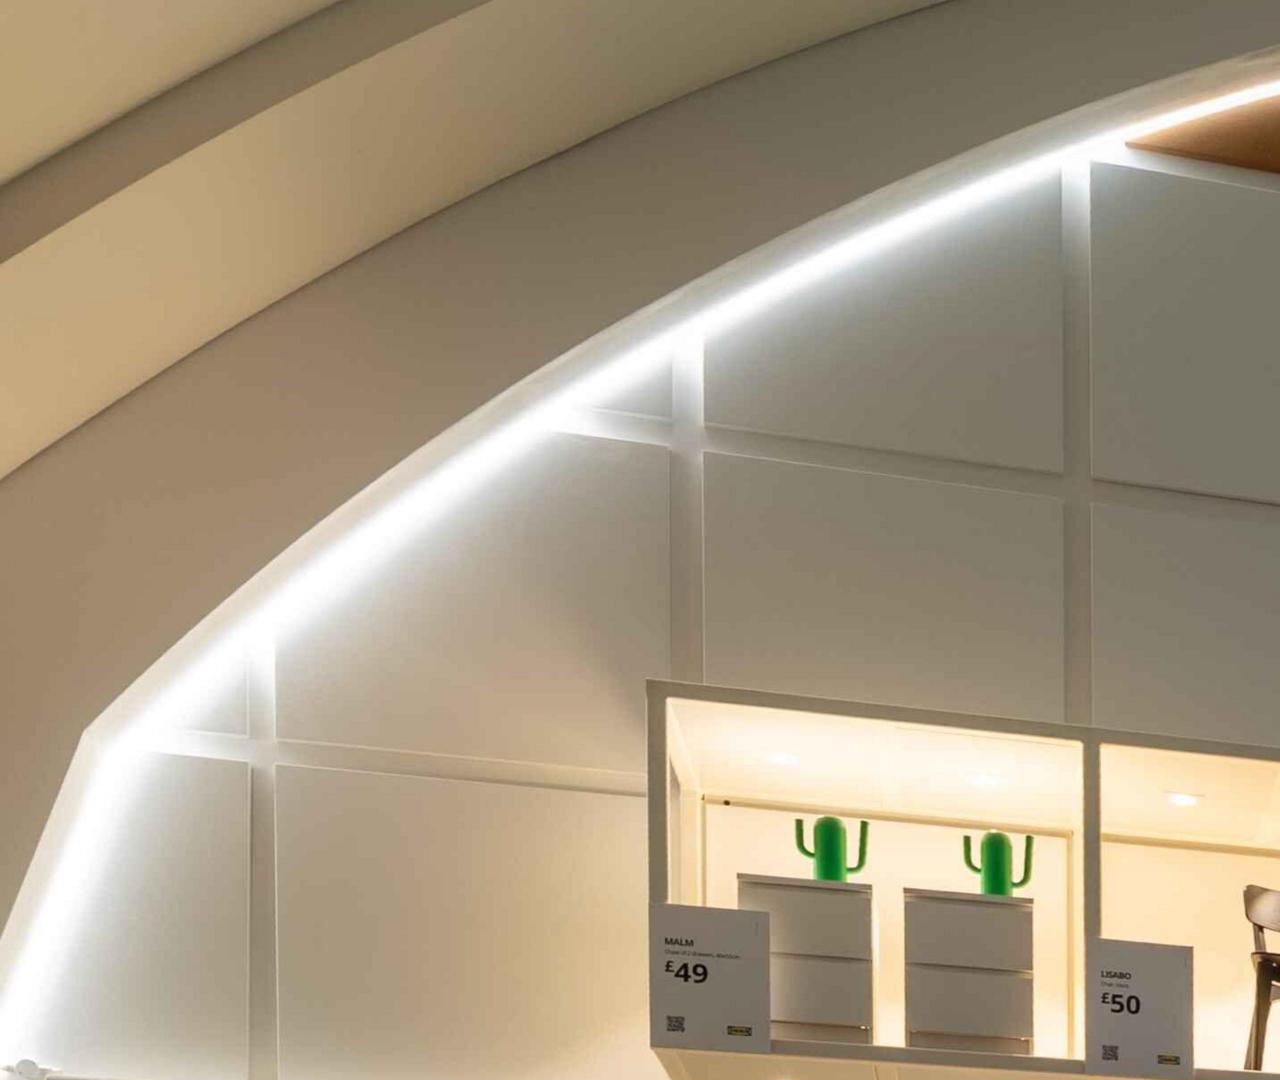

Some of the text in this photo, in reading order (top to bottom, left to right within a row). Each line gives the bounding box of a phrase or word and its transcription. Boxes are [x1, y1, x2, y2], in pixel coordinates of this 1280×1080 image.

[664, 936, 695, 948] MALM
[664, 959, 709, 984] £49
[1100, 969, 1132, 981] LISABO
[1100, 991, 1141, 1015] £50
